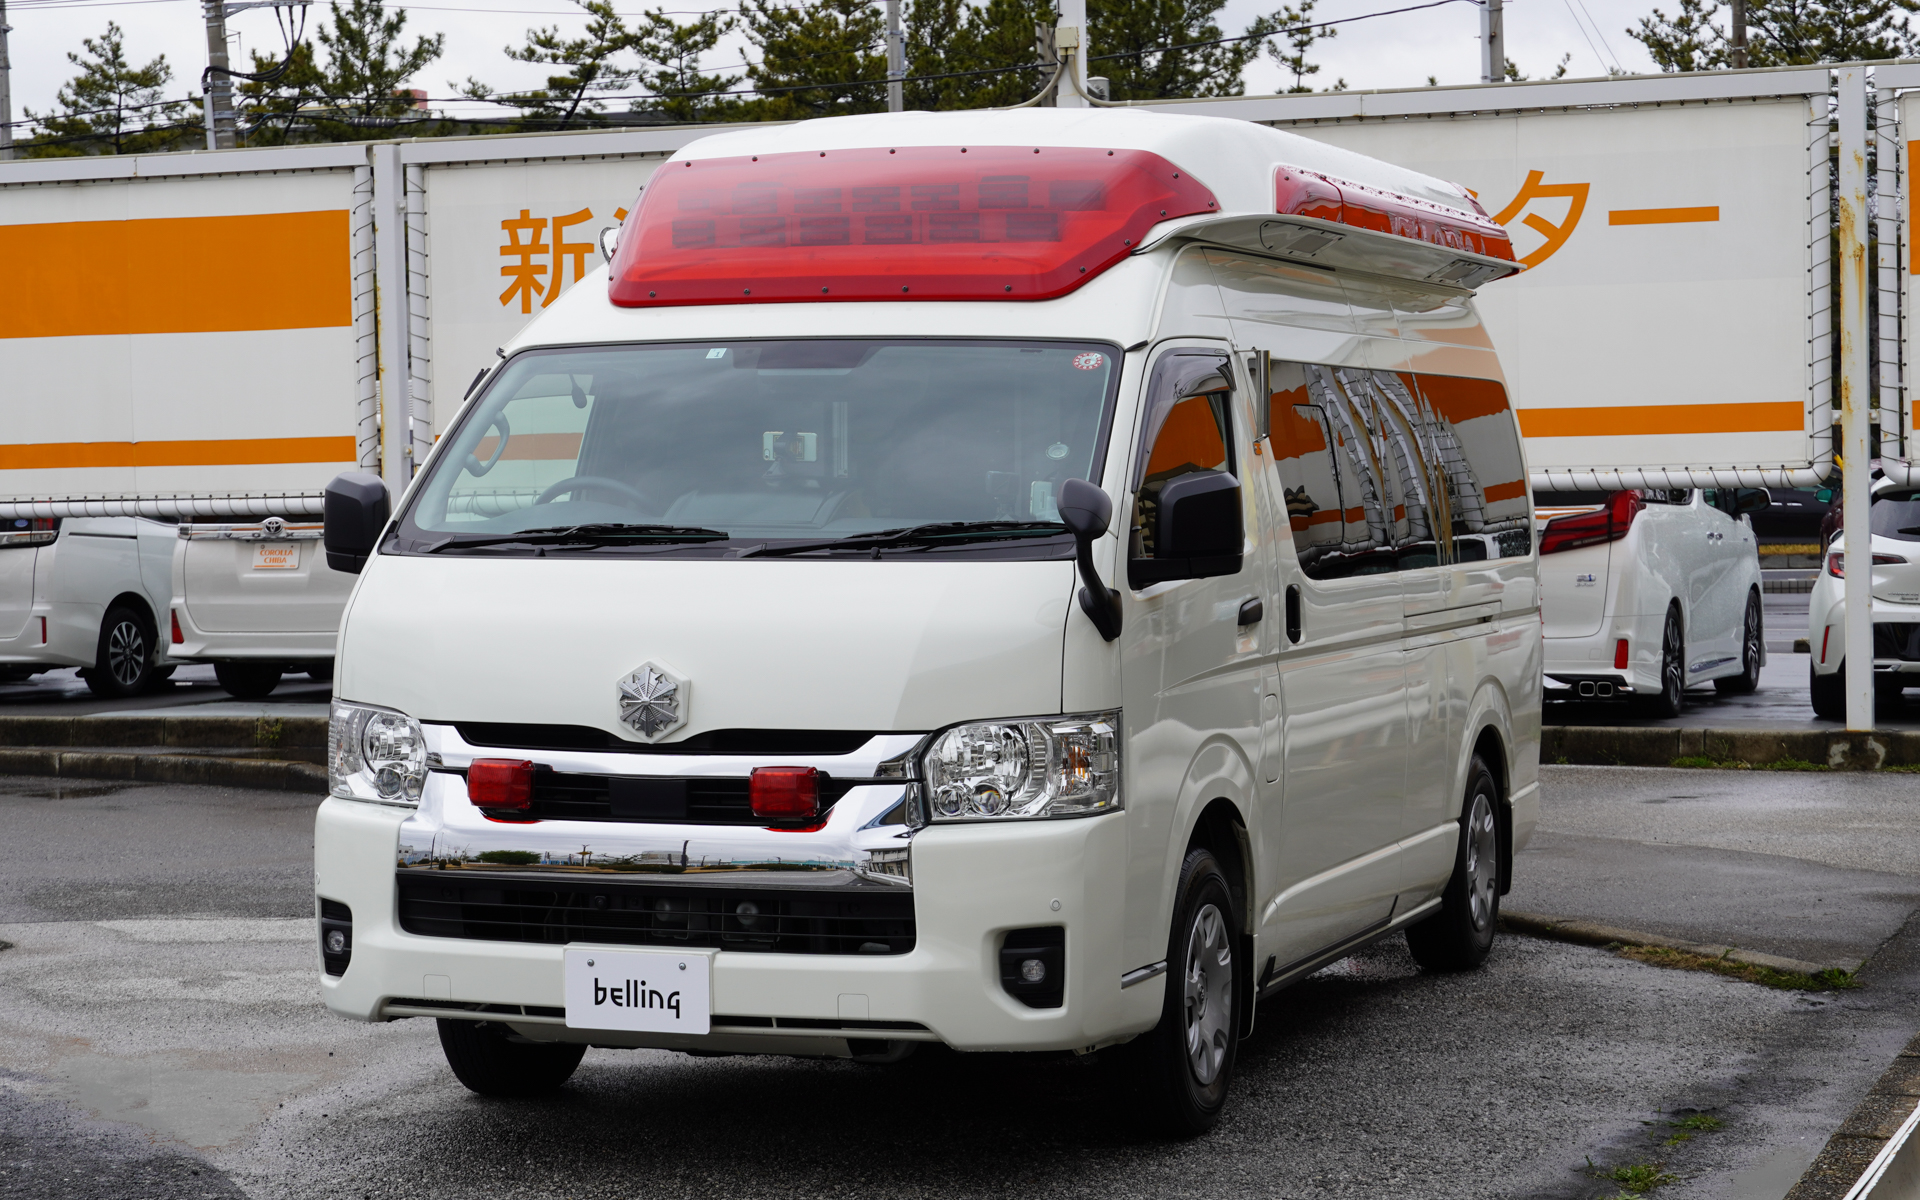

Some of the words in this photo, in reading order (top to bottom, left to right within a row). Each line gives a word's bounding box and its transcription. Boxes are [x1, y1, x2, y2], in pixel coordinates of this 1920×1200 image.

[499, 207, 628, 314] 新
[1465, 169, 1720, 278] ター
[259, 549, 294, 557] COROLLA
[263, 556, 287, 564] CHIBA
[594, 977, 680, 1019] belling
